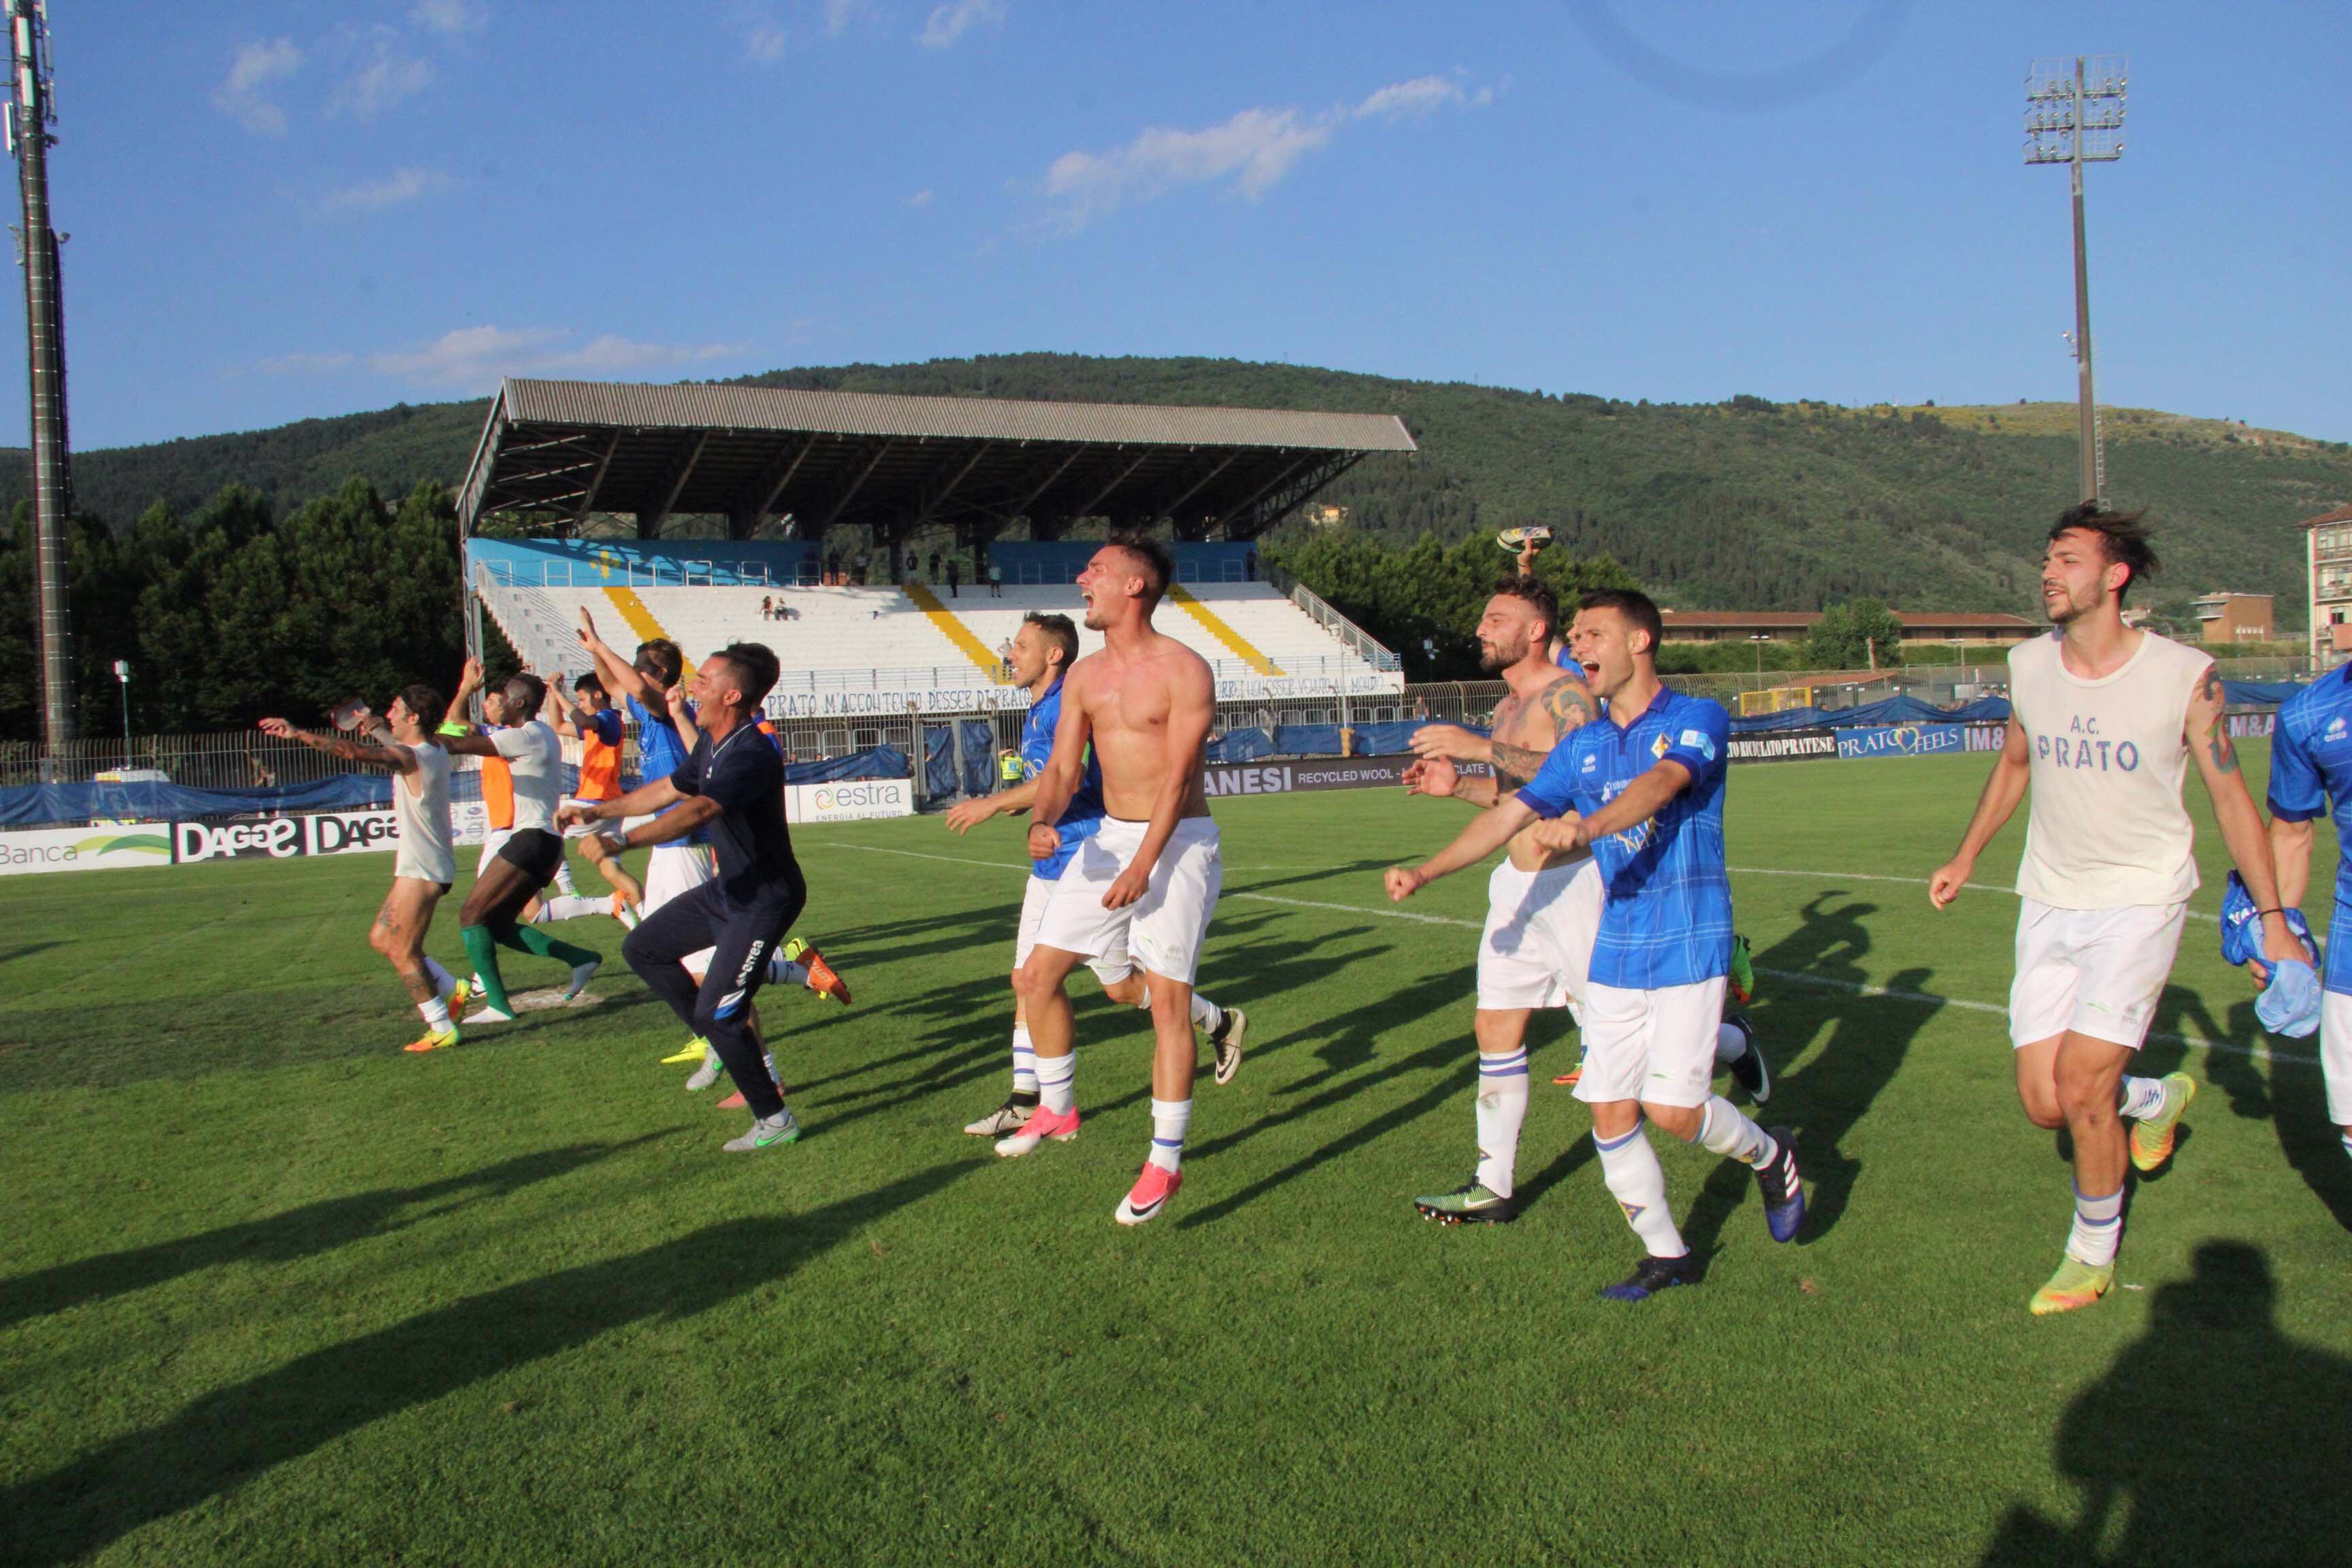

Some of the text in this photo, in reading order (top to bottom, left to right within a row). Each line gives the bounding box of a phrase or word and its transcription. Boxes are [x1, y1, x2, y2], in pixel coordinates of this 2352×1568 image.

[768, 694, 817, 715] PRATO
[995, 688, 1031, 708] PRATO
[2070, 715, 2100, 734] A.C.
[1782, 736, 1835, 755] PRATESE
[1838, 728, 1958, 759] PRATO FEELS
[2038, 735, 2138, 772] PRATO
[1298, 770, 1358, 784] RECYCLED
[1360, 768, 1394, 781] WOOL
[836, 783, 901, 806] estra
[817, 813, 854, 822] ENERGIA
[870, 810, 902, 819] FUTURO
[0, 844, 78, 864] Banca
